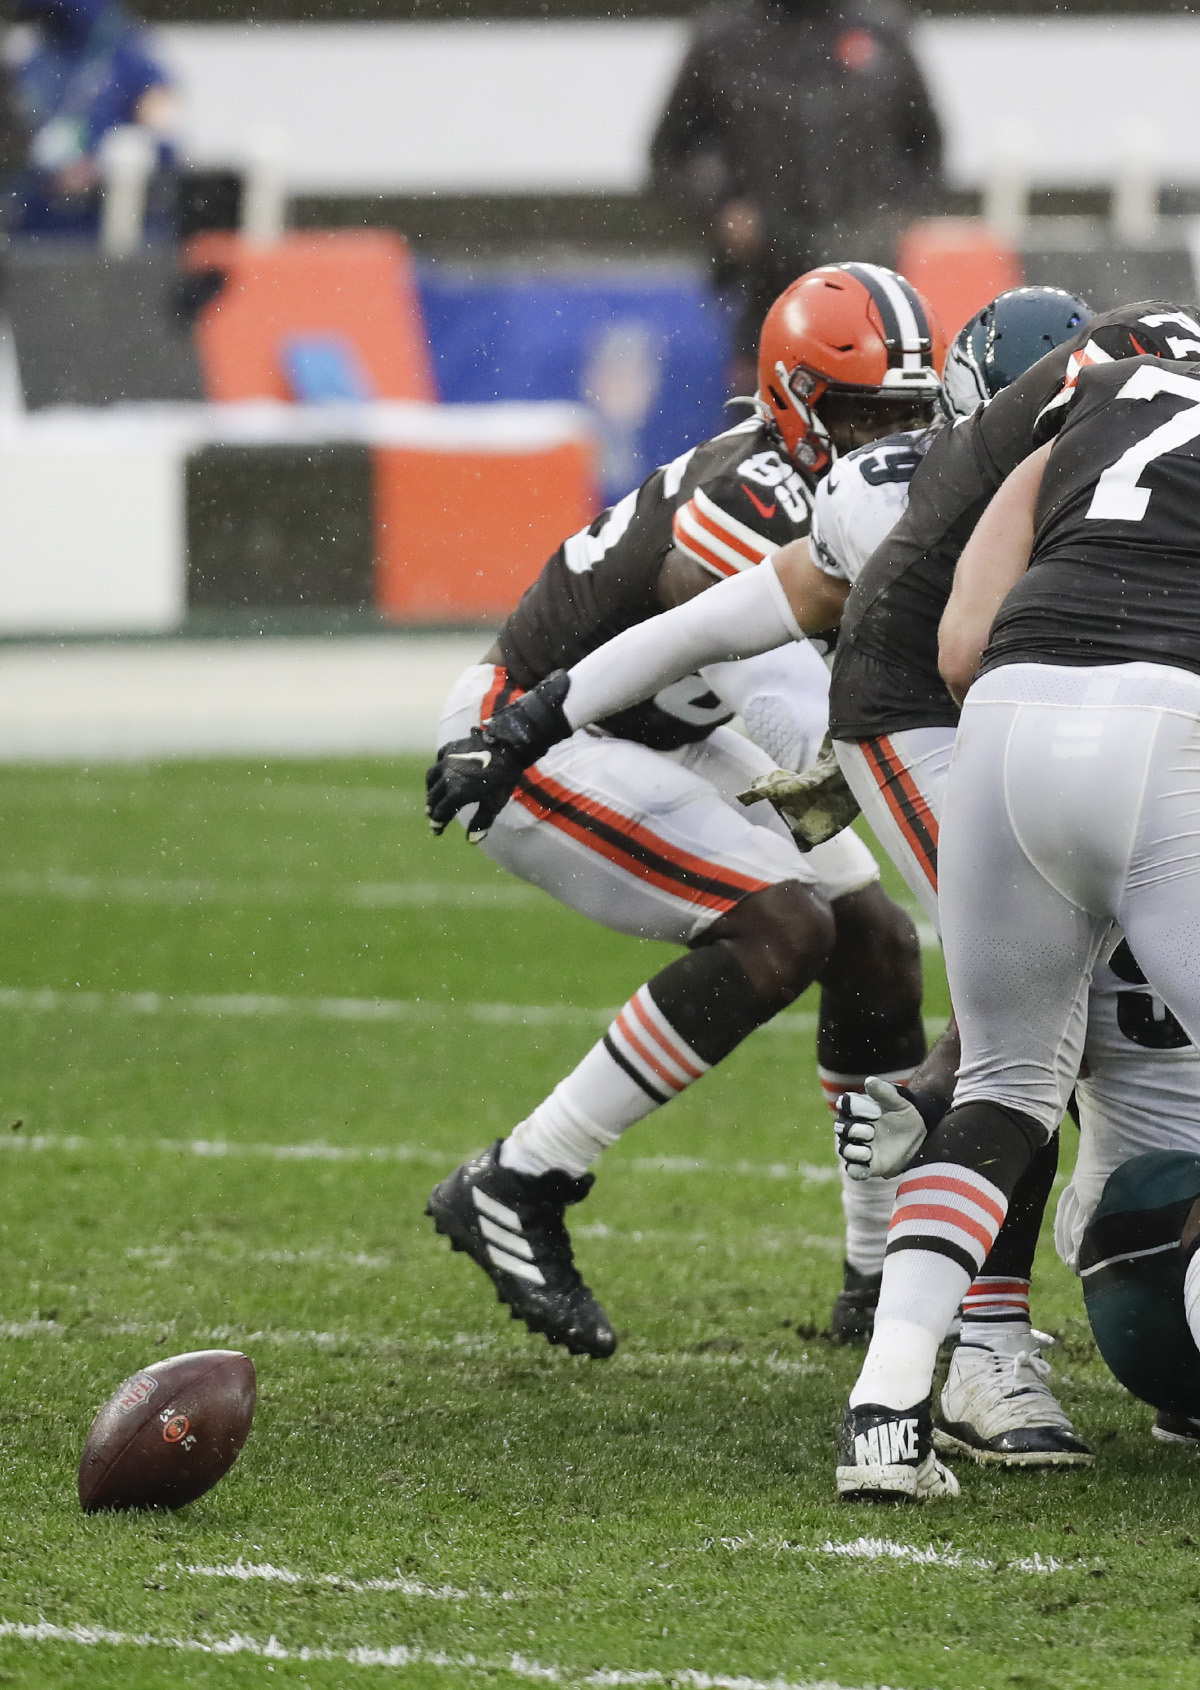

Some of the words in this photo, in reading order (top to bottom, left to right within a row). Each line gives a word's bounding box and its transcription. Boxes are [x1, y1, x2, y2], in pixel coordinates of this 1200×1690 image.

[736, 451, 816, 523] 85
[120, 1379, 154, 1408] NFL
[854, 1418, 919, 1466] NIKE
